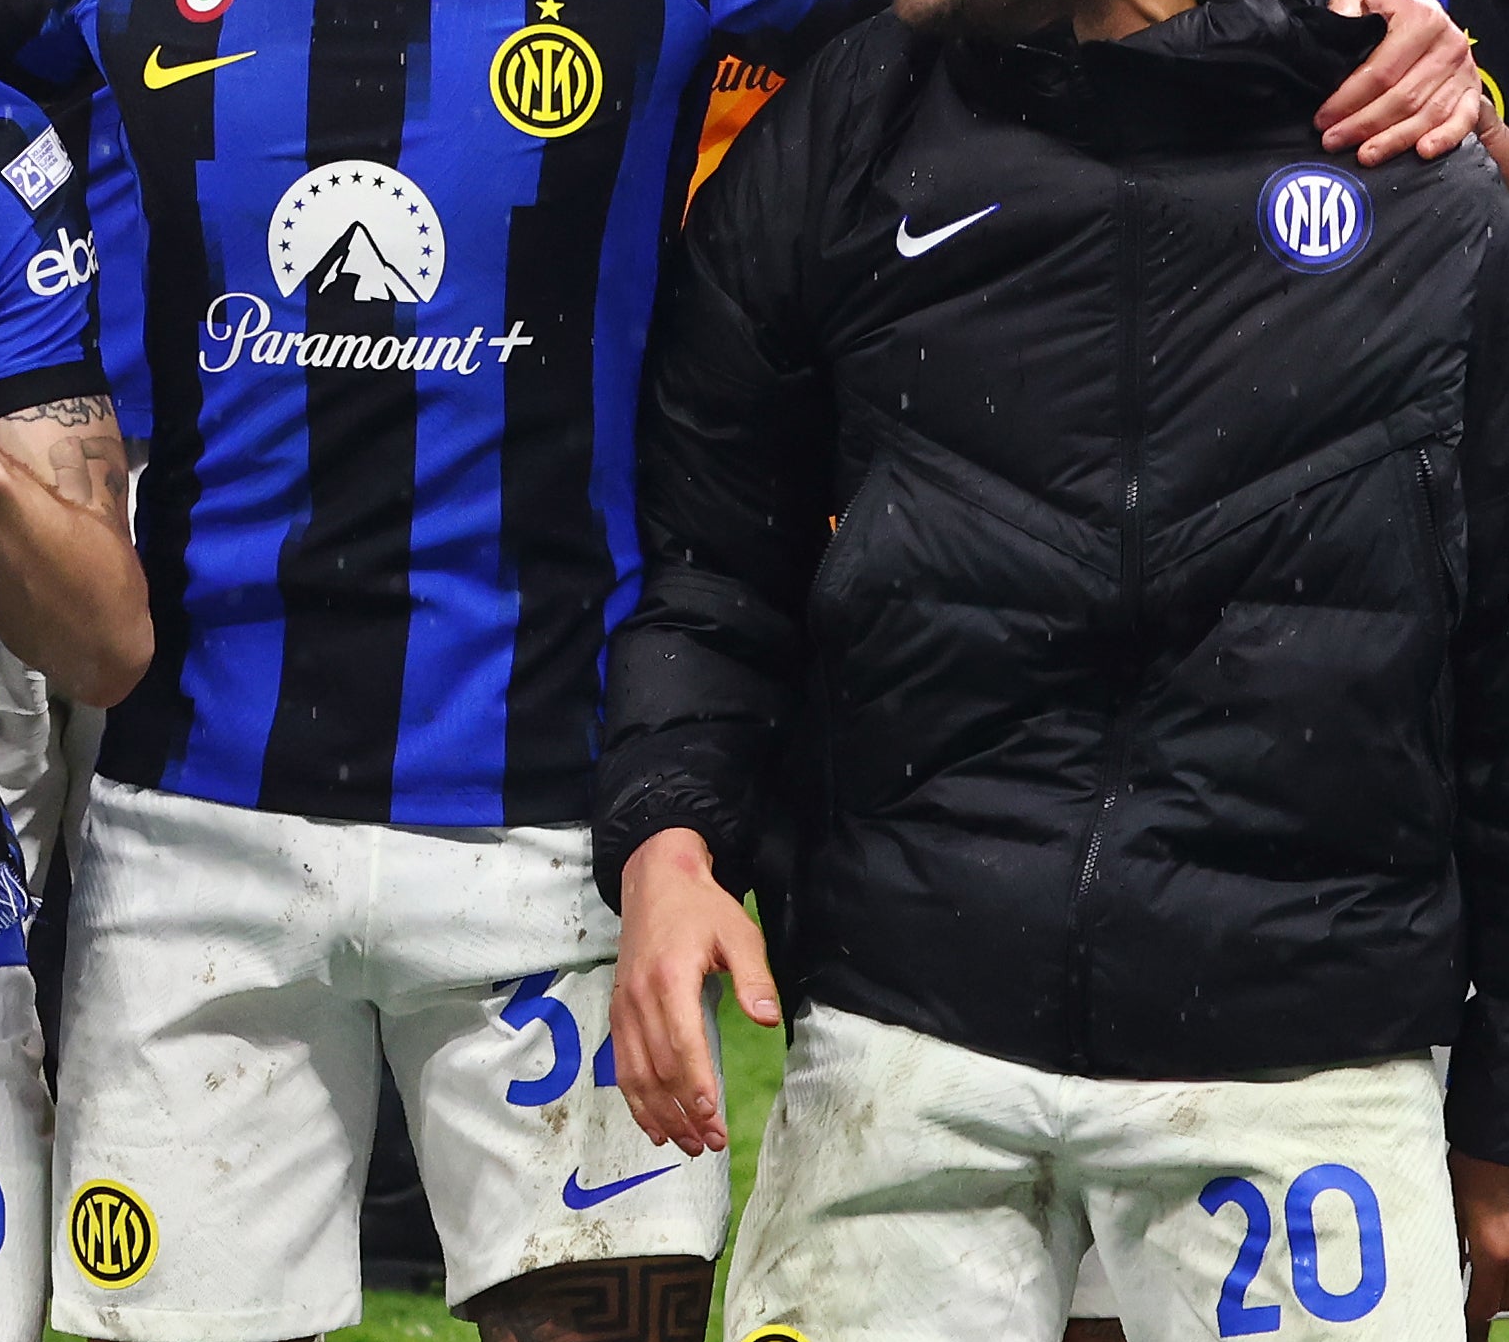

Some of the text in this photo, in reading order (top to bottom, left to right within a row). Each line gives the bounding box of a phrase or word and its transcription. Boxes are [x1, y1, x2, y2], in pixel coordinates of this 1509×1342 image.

[11, 158, 46, 199] 23
[199, 292, 534, 376] Paramount+
[492, 969, 618, 1108] 3
[1197, 1162, 1388, 1339] 20
